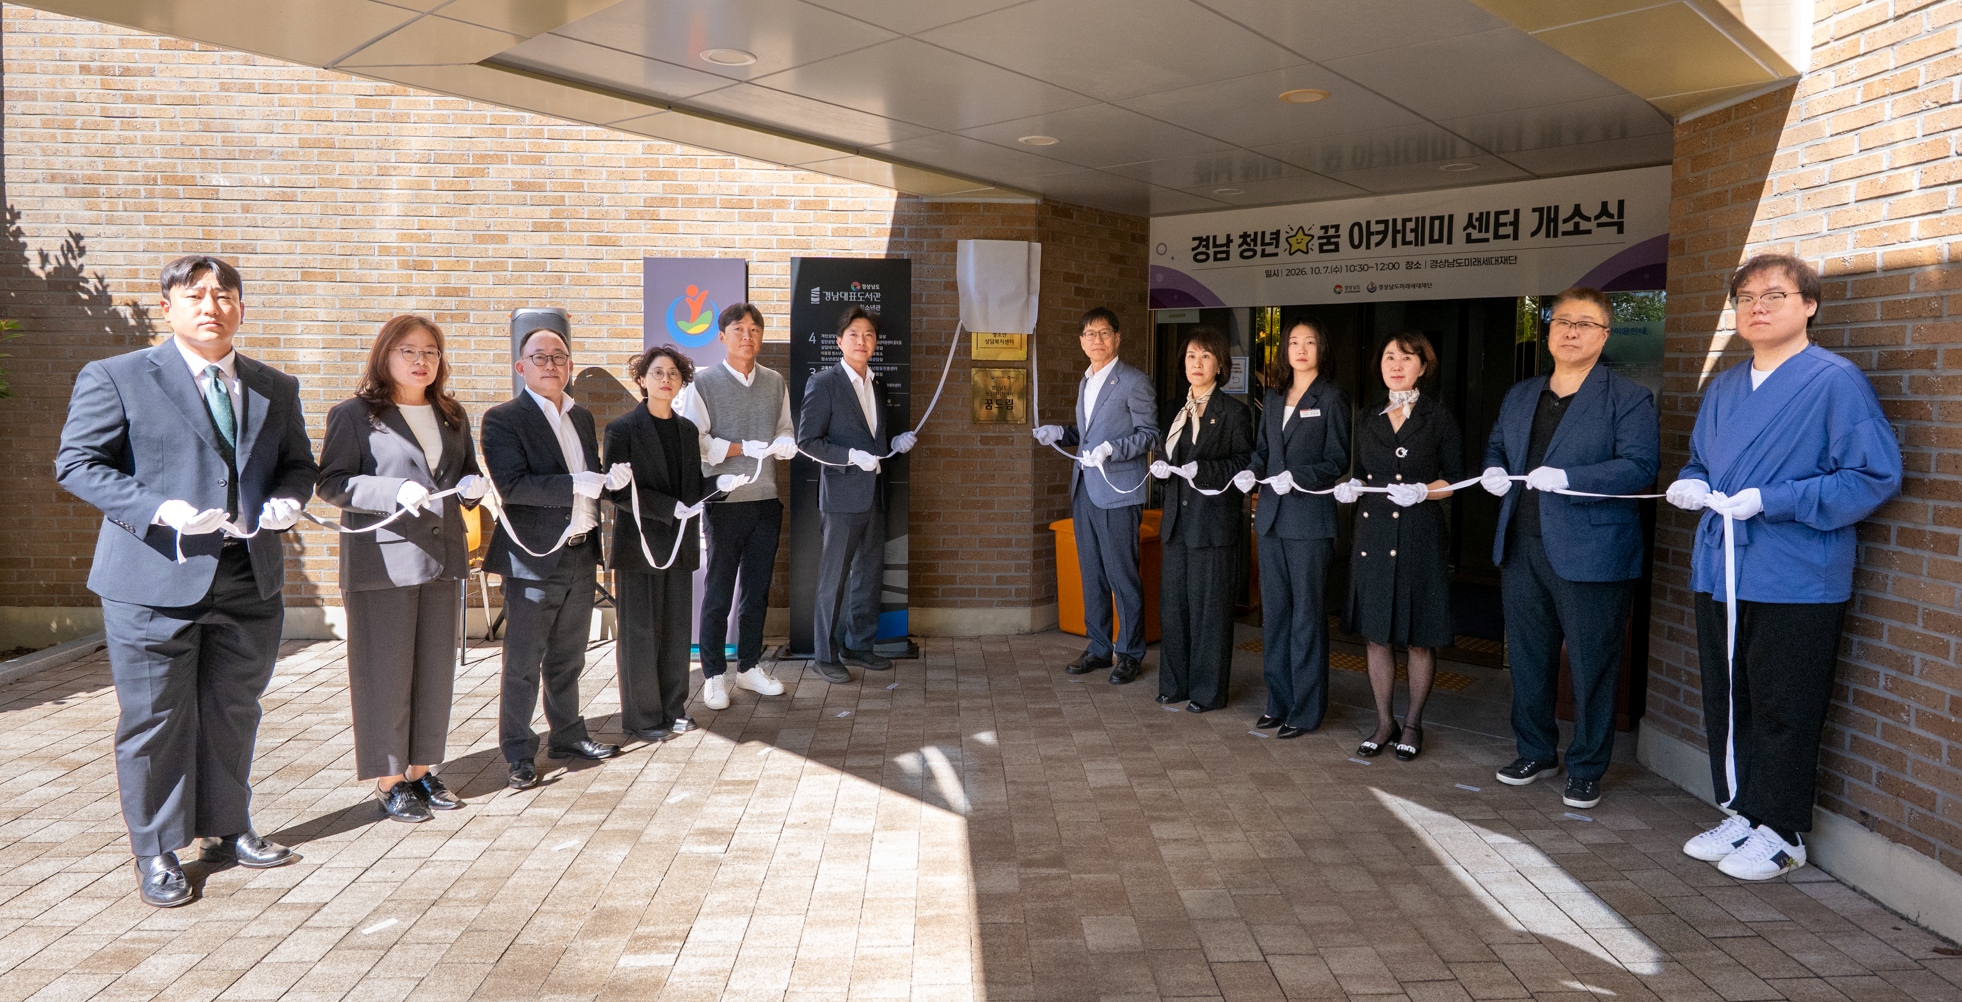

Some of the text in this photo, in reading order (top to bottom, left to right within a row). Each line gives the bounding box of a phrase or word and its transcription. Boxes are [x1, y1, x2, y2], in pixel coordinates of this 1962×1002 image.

[1191, 199, 1625, 264] 경남 청년 꿈 아카데미 센터 개소식
[1264, 269, 1279, 278] 일시
[1285, 268, 1308, 277] 2026.
[1345, 262, 1401, 273] 10:30~12:00
[1405, 260, 1422, 271] 장소
[1430, 255, 1518, 269] 경상남도미래세대재단
[823, 292, 881, 302] 경남대표도서관
[808, 333, 817, 345] 4
[985, 398, 1013, 410] 꿈드림
